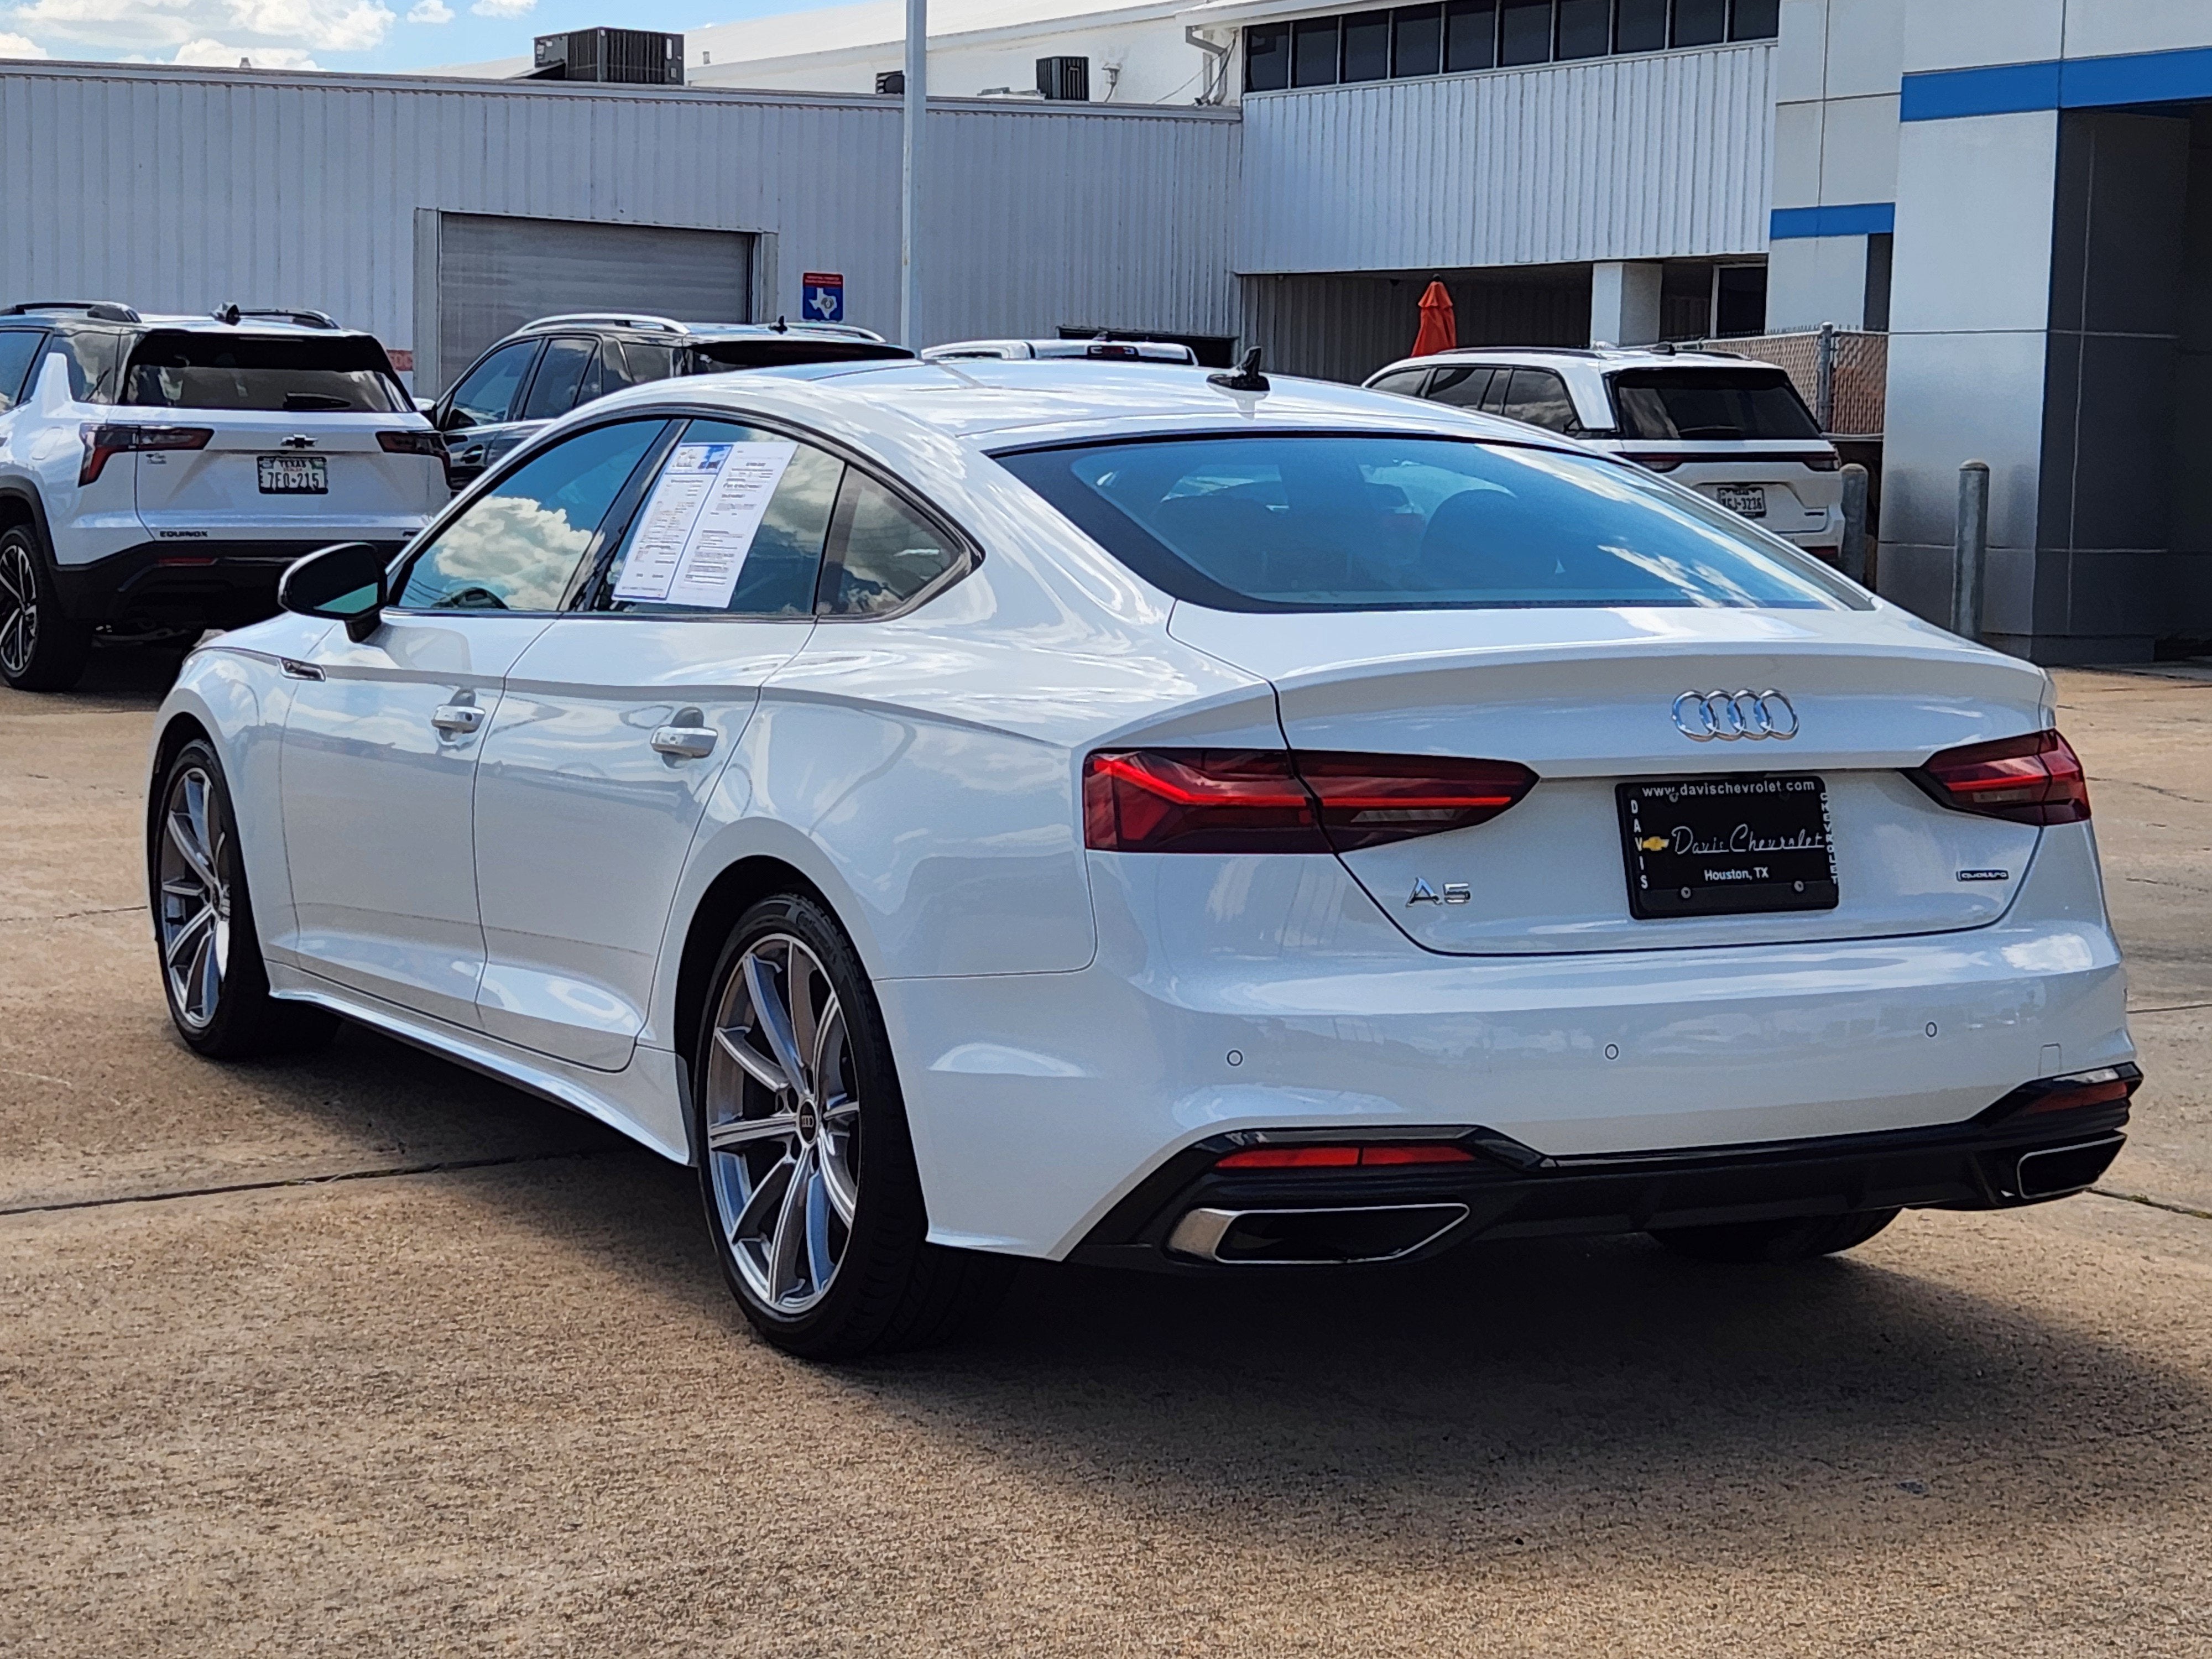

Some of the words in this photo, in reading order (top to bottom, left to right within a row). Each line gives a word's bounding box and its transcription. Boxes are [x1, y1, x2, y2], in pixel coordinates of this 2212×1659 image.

[1641, 780, 1815, 797] www.davischevrolet.com
[1630, 799, 1648, 889] DAVIS
[1671, 826, 1729, 855] Davis
[1729, 823, 1825, 852] Chevrolet
[1704, 868, 1752, 881] Houston,
[1753, 866, 1769, 878] TX
[1405, 877, 1471, 907] A5
